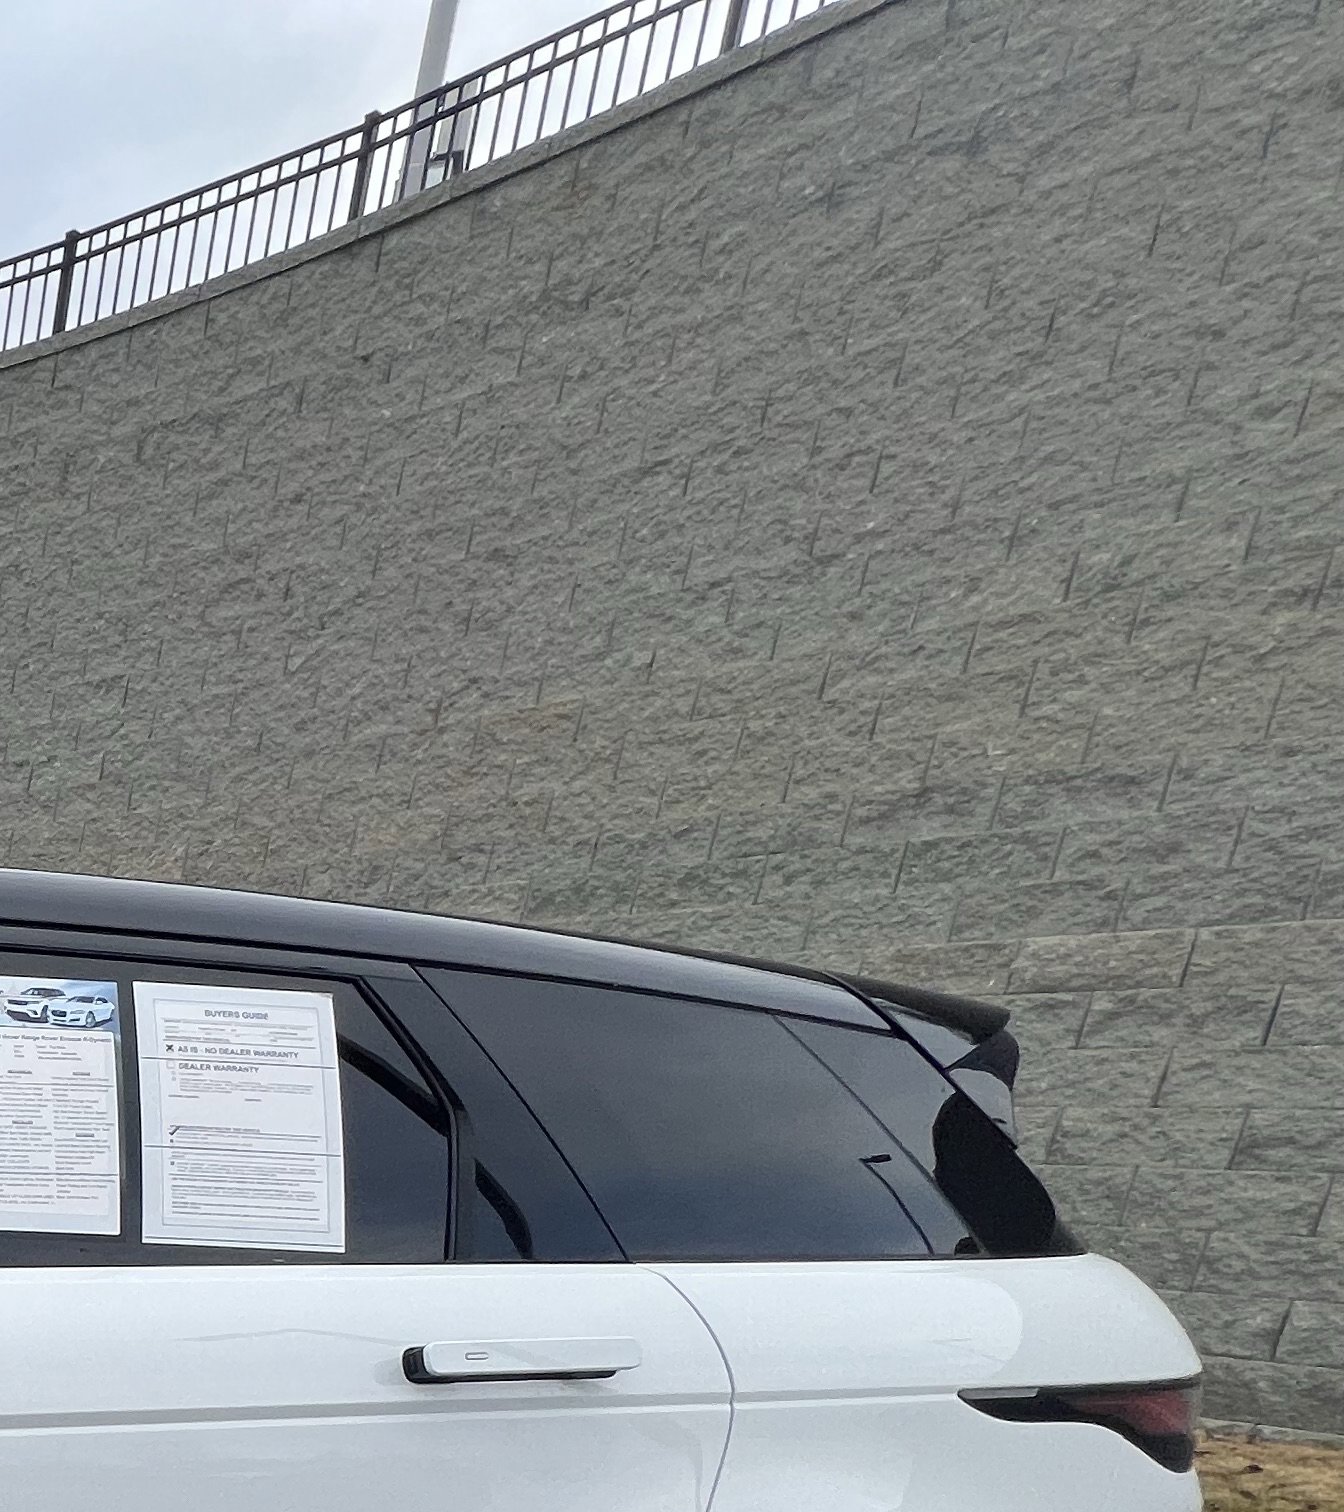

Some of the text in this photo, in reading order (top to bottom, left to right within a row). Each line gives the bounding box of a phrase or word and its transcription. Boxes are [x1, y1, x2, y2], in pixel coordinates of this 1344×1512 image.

[204, 1009, 269, 1020] BUYERS GUIDE
[219, 1048, 251, 1057] DEALER
[253, 1049, 299, 1059] WARRANTY
[178, 1062, 260, 1073] DEALER WARRANTY
